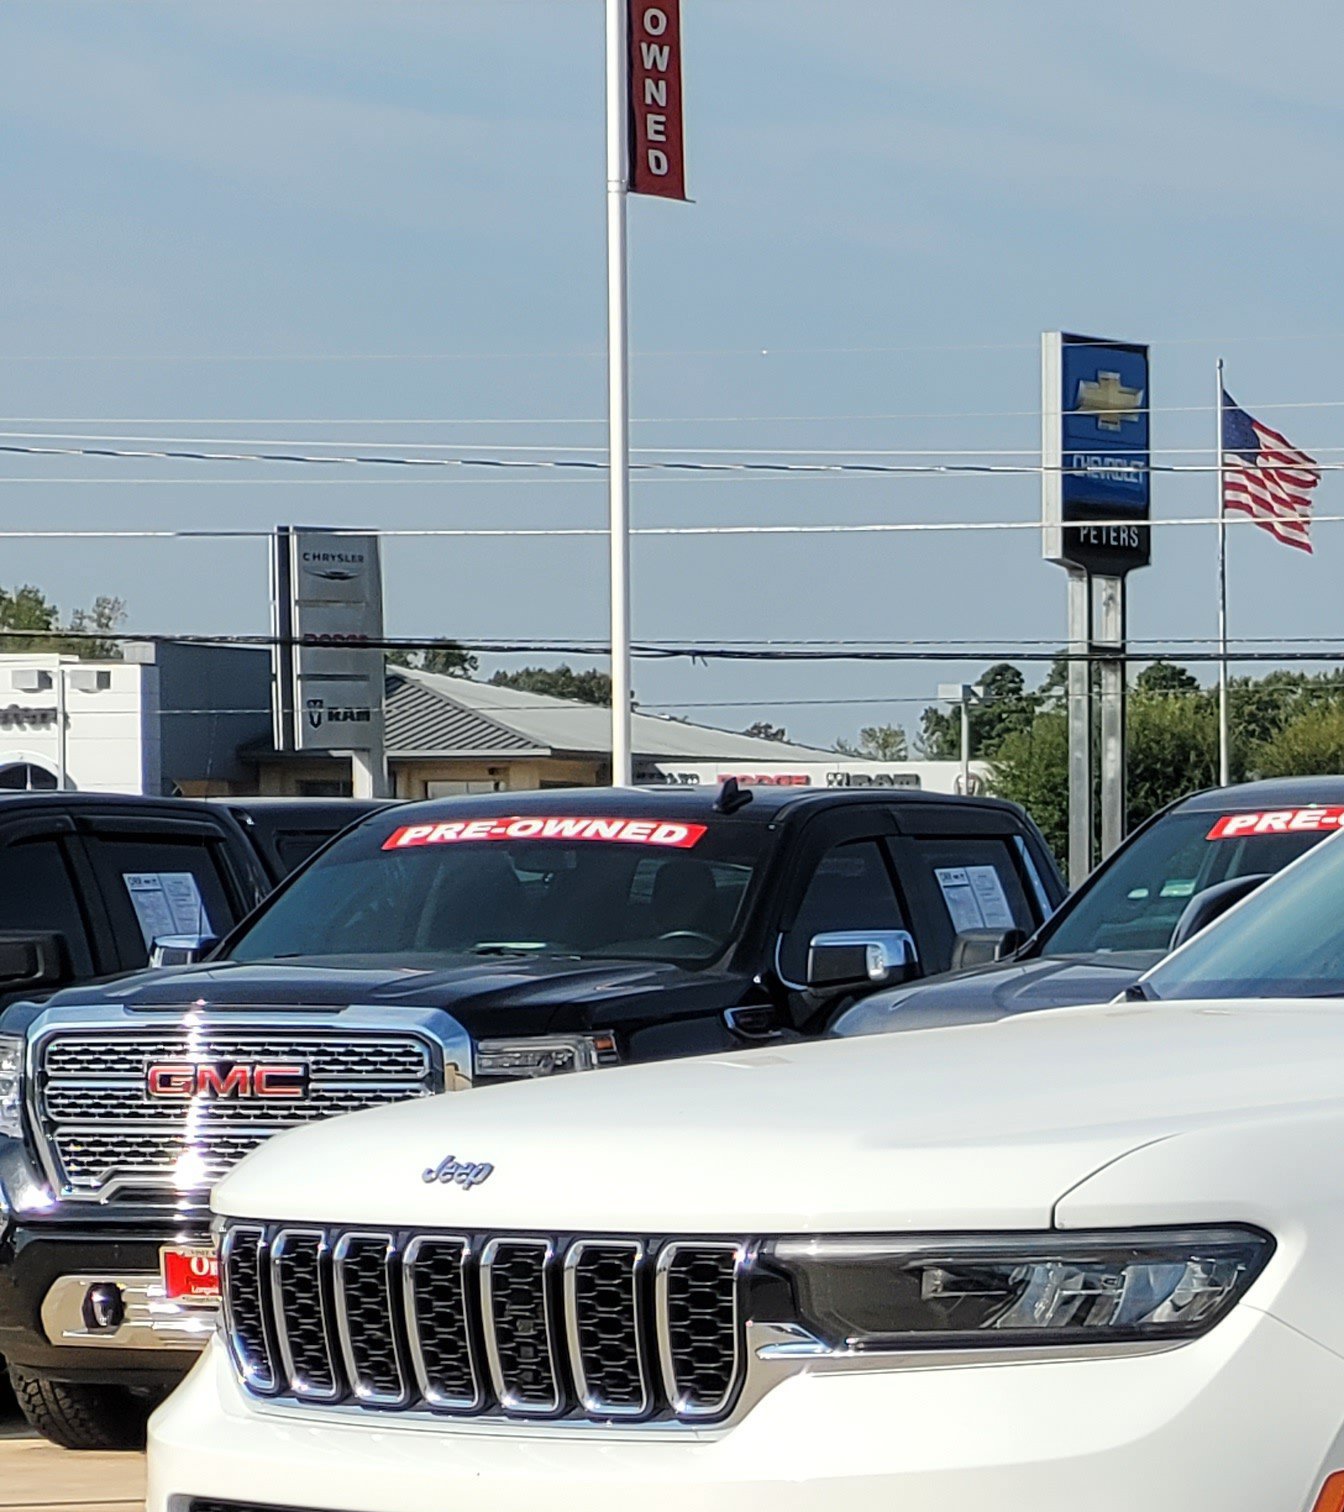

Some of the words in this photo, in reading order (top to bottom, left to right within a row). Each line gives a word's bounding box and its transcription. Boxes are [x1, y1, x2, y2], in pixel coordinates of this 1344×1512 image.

[640, 8, 669, 176] OWNED
[1073, 454, 1145, 484] CHEVROLET
[1080, 525, 1138, 547] PETERS
[302, 552, 364, 564] CHRYSLER
[397, 819, 689, 845] PRE-OWNED
[148, 1064, 304, 1098] GMC
[421, 1155, 495, 1191] Jeep
